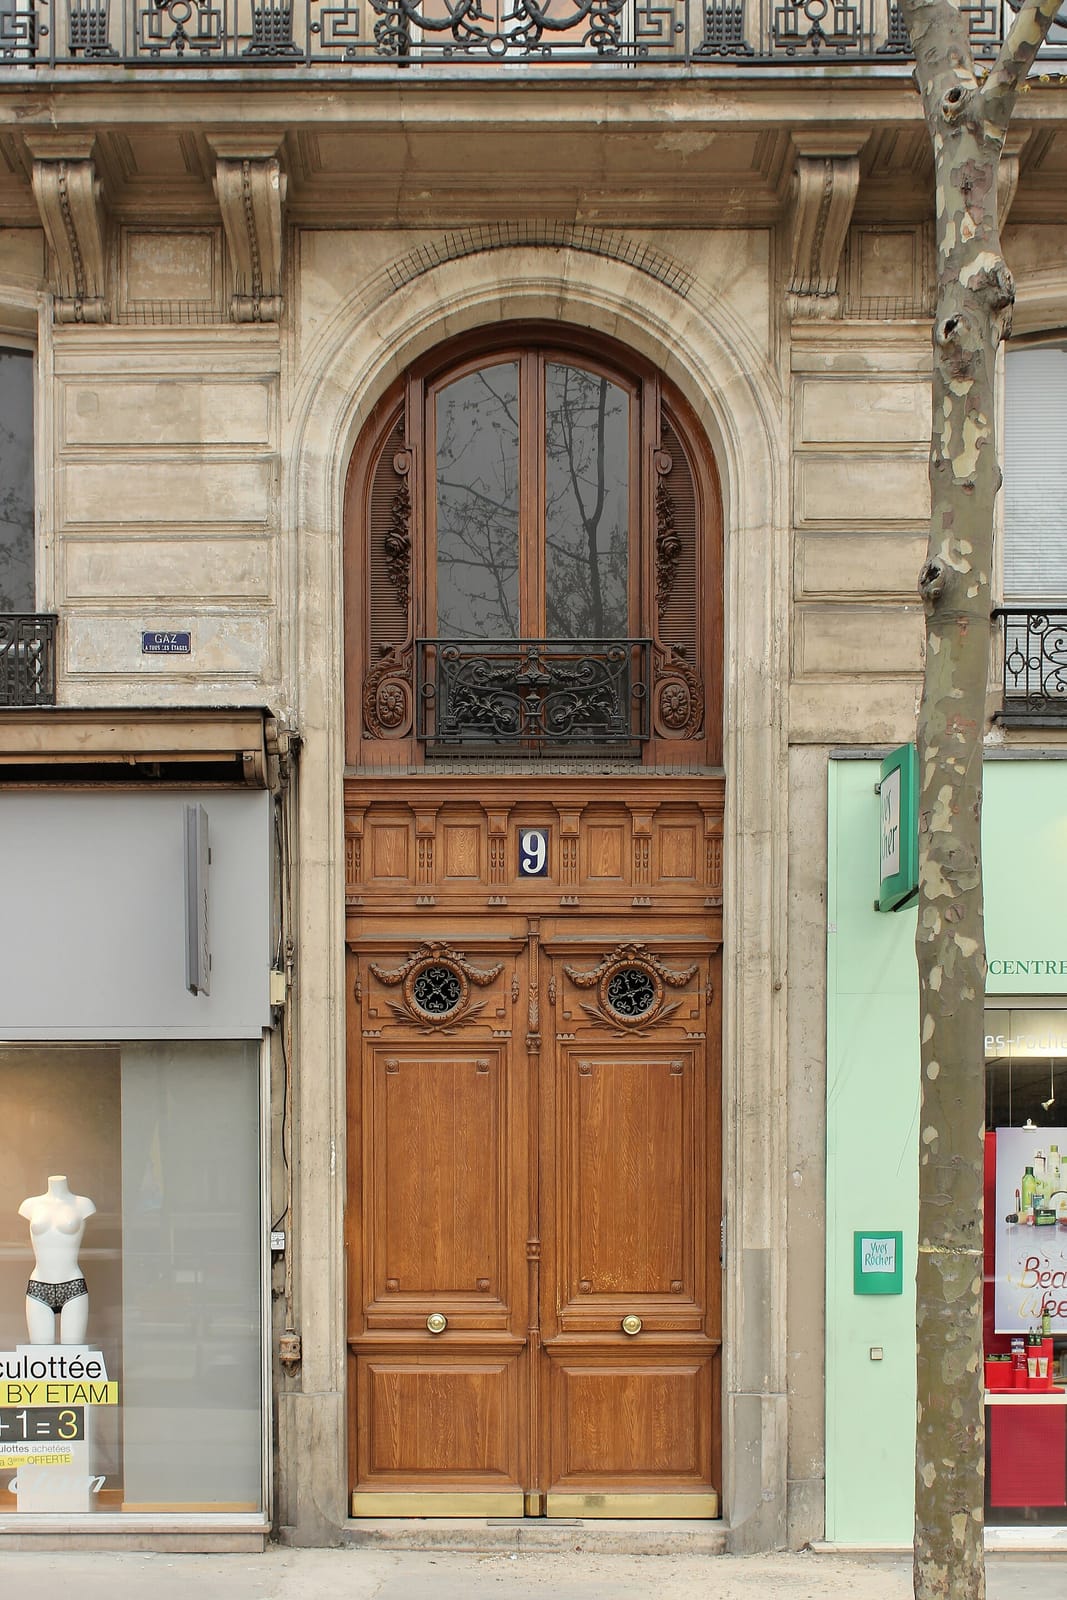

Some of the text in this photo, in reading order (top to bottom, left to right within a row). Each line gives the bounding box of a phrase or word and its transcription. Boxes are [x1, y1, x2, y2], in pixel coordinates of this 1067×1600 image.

[154, 633, 177, 644] GAZ
[522, 831, 546, 874] 9
[989, 960, 1067, 975] CENTRE
[870, 1242, 888, 1255] Yves
[864, 1252, 893, 1266] Rocher
[0, 1355, 102, 1379] ulottée
[7, 1384, 109, 1404] BY ETAM
[27, 1454, 71, 1465] OFFERTE
